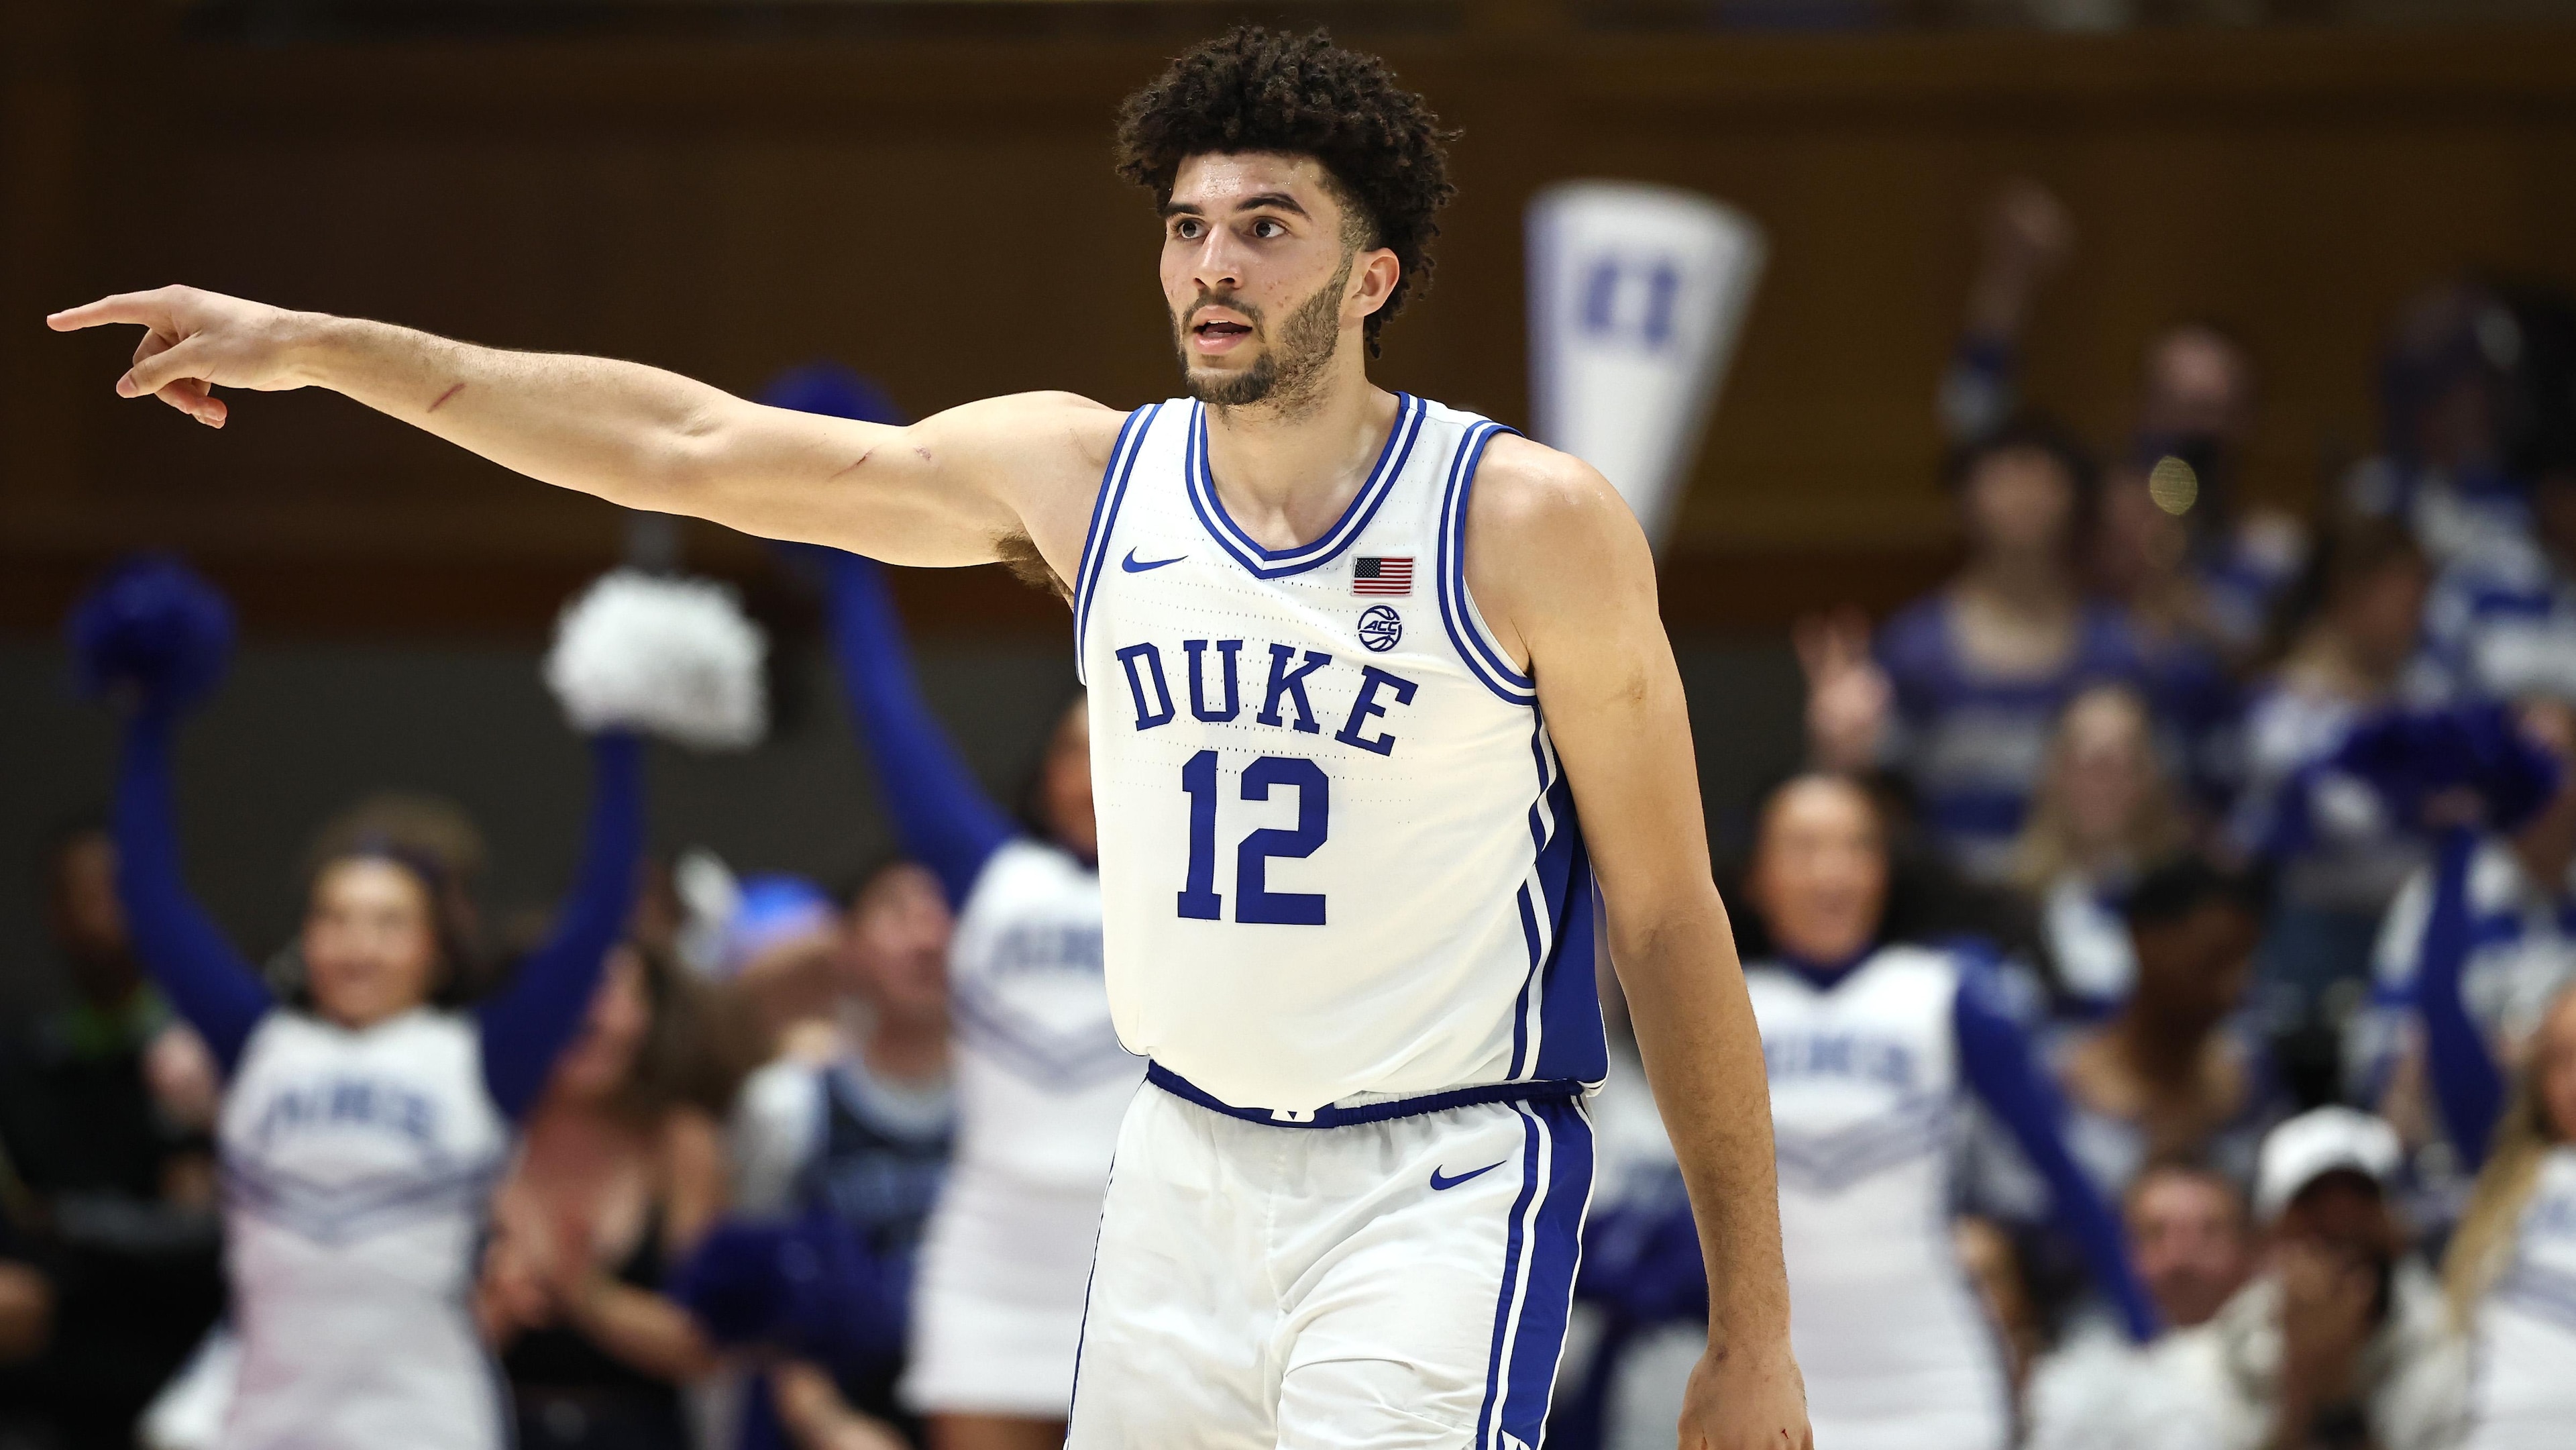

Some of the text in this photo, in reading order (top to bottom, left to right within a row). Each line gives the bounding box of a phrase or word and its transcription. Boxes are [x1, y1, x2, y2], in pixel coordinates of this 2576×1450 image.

[1363, 621, 1401, 631] ACC
[1116, 639, 1419, 757] DUKE
[1177, 749, 1329, 925] 12
